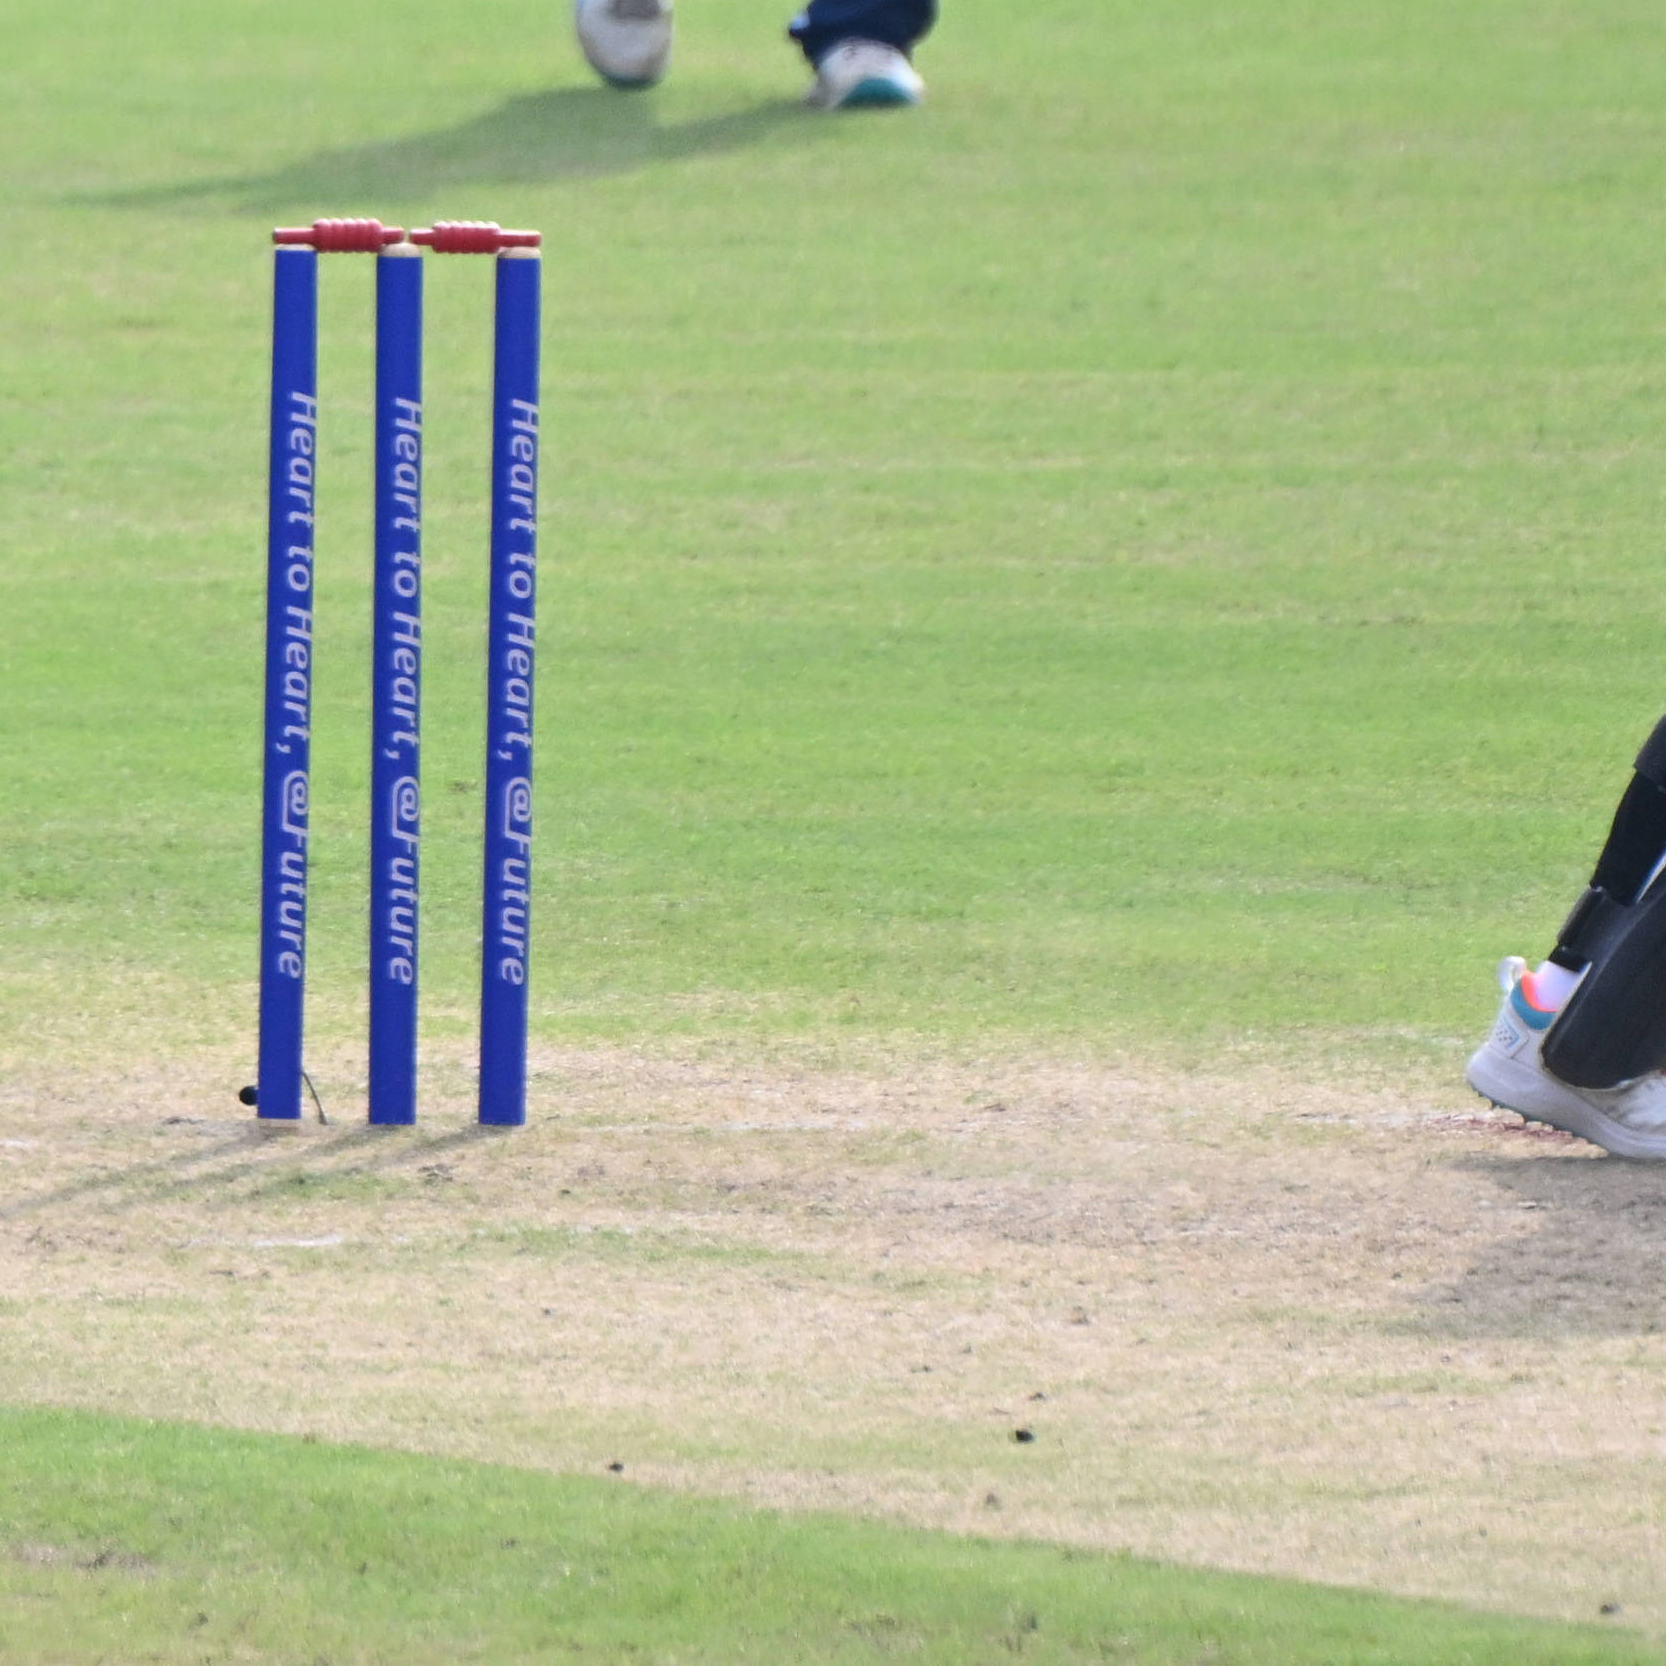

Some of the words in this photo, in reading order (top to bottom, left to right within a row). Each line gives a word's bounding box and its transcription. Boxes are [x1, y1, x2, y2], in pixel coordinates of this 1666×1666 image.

[289, 391, 317, 530] Heart
[394, 396, 423, 534] Heart
[509, 398, 539, 536] Heart
[287, 544, 315, 592] to
[393, 550, 422, 599] to
[507, 552, 537, 600] to
[276, 605, 313, 754] Heart,
[383, 610, 421, 760] Heart,
[498, 612, 536, 760] Heart,
